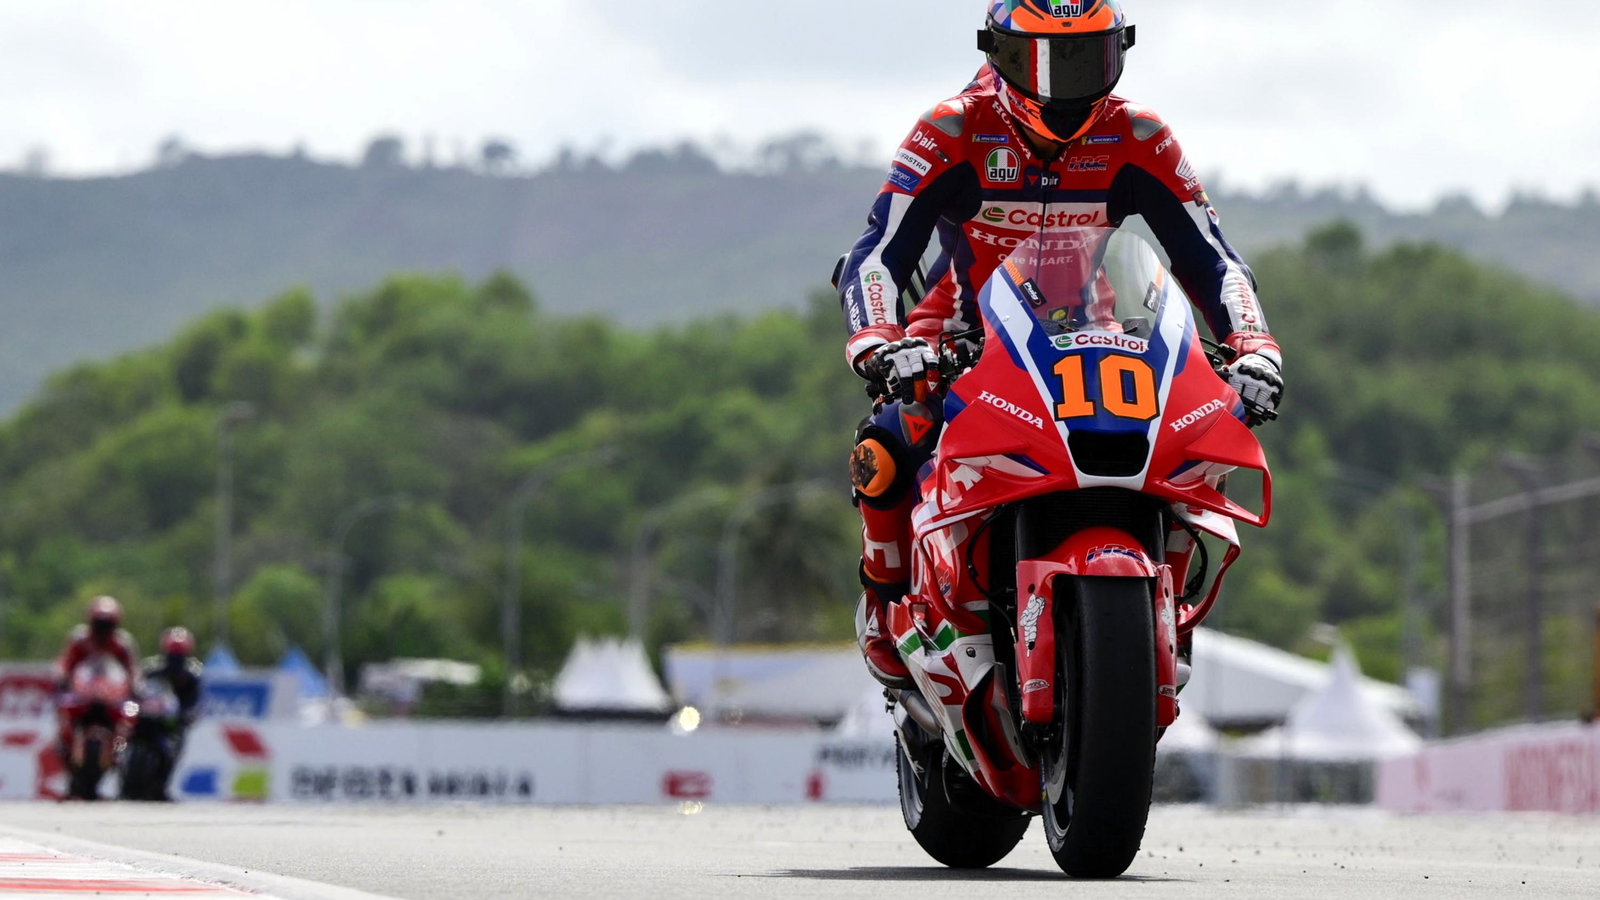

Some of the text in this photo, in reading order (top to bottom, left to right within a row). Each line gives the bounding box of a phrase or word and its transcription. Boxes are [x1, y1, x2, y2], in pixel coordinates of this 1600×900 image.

[1054, 4, 1079, 18] agv
[990, 167, 1016, 181] agv
[1008, 209, 1099, 228] Castrol
[867, 283, 888, 325] Castro
[1075, 333, 1145, 352] Castrol
[1053, 353, 1160, 421] 10
[977, 390, 1044, 430] HONDA
[1169, 398, 1226, 432] HONDA
